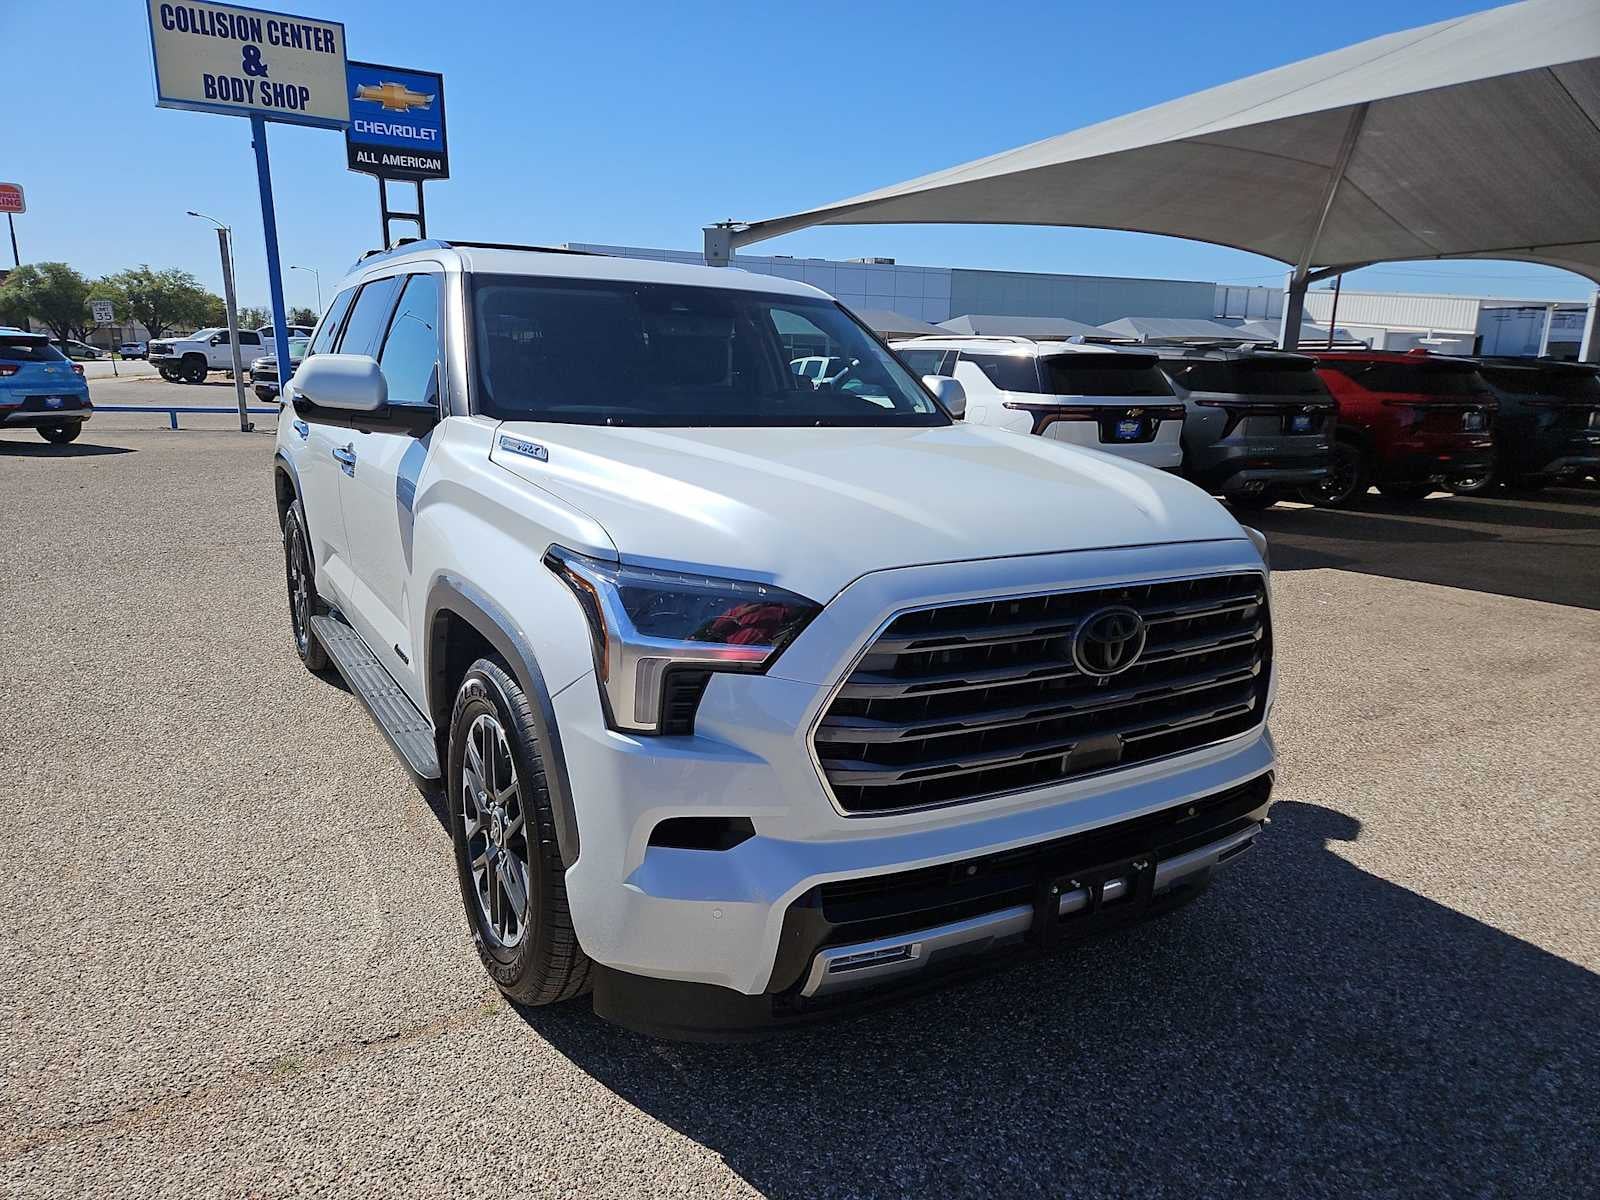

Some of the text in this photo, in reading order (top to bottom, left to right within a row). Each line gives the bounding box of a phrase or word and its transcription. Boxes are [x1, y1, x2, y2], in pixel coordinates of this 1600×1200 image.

[160, 3, 336, 54] COLLISION CENTER
[242, 44, 269, 78] &
[203, 73, 310, 111] BODY SHOP
[354, 119, 438, 141] CHEVROLET
[356, 151, 441, 170] ALL AMERICAN
[0, 198, 21, 206] ING
[95, 312, 112, 321] 35
